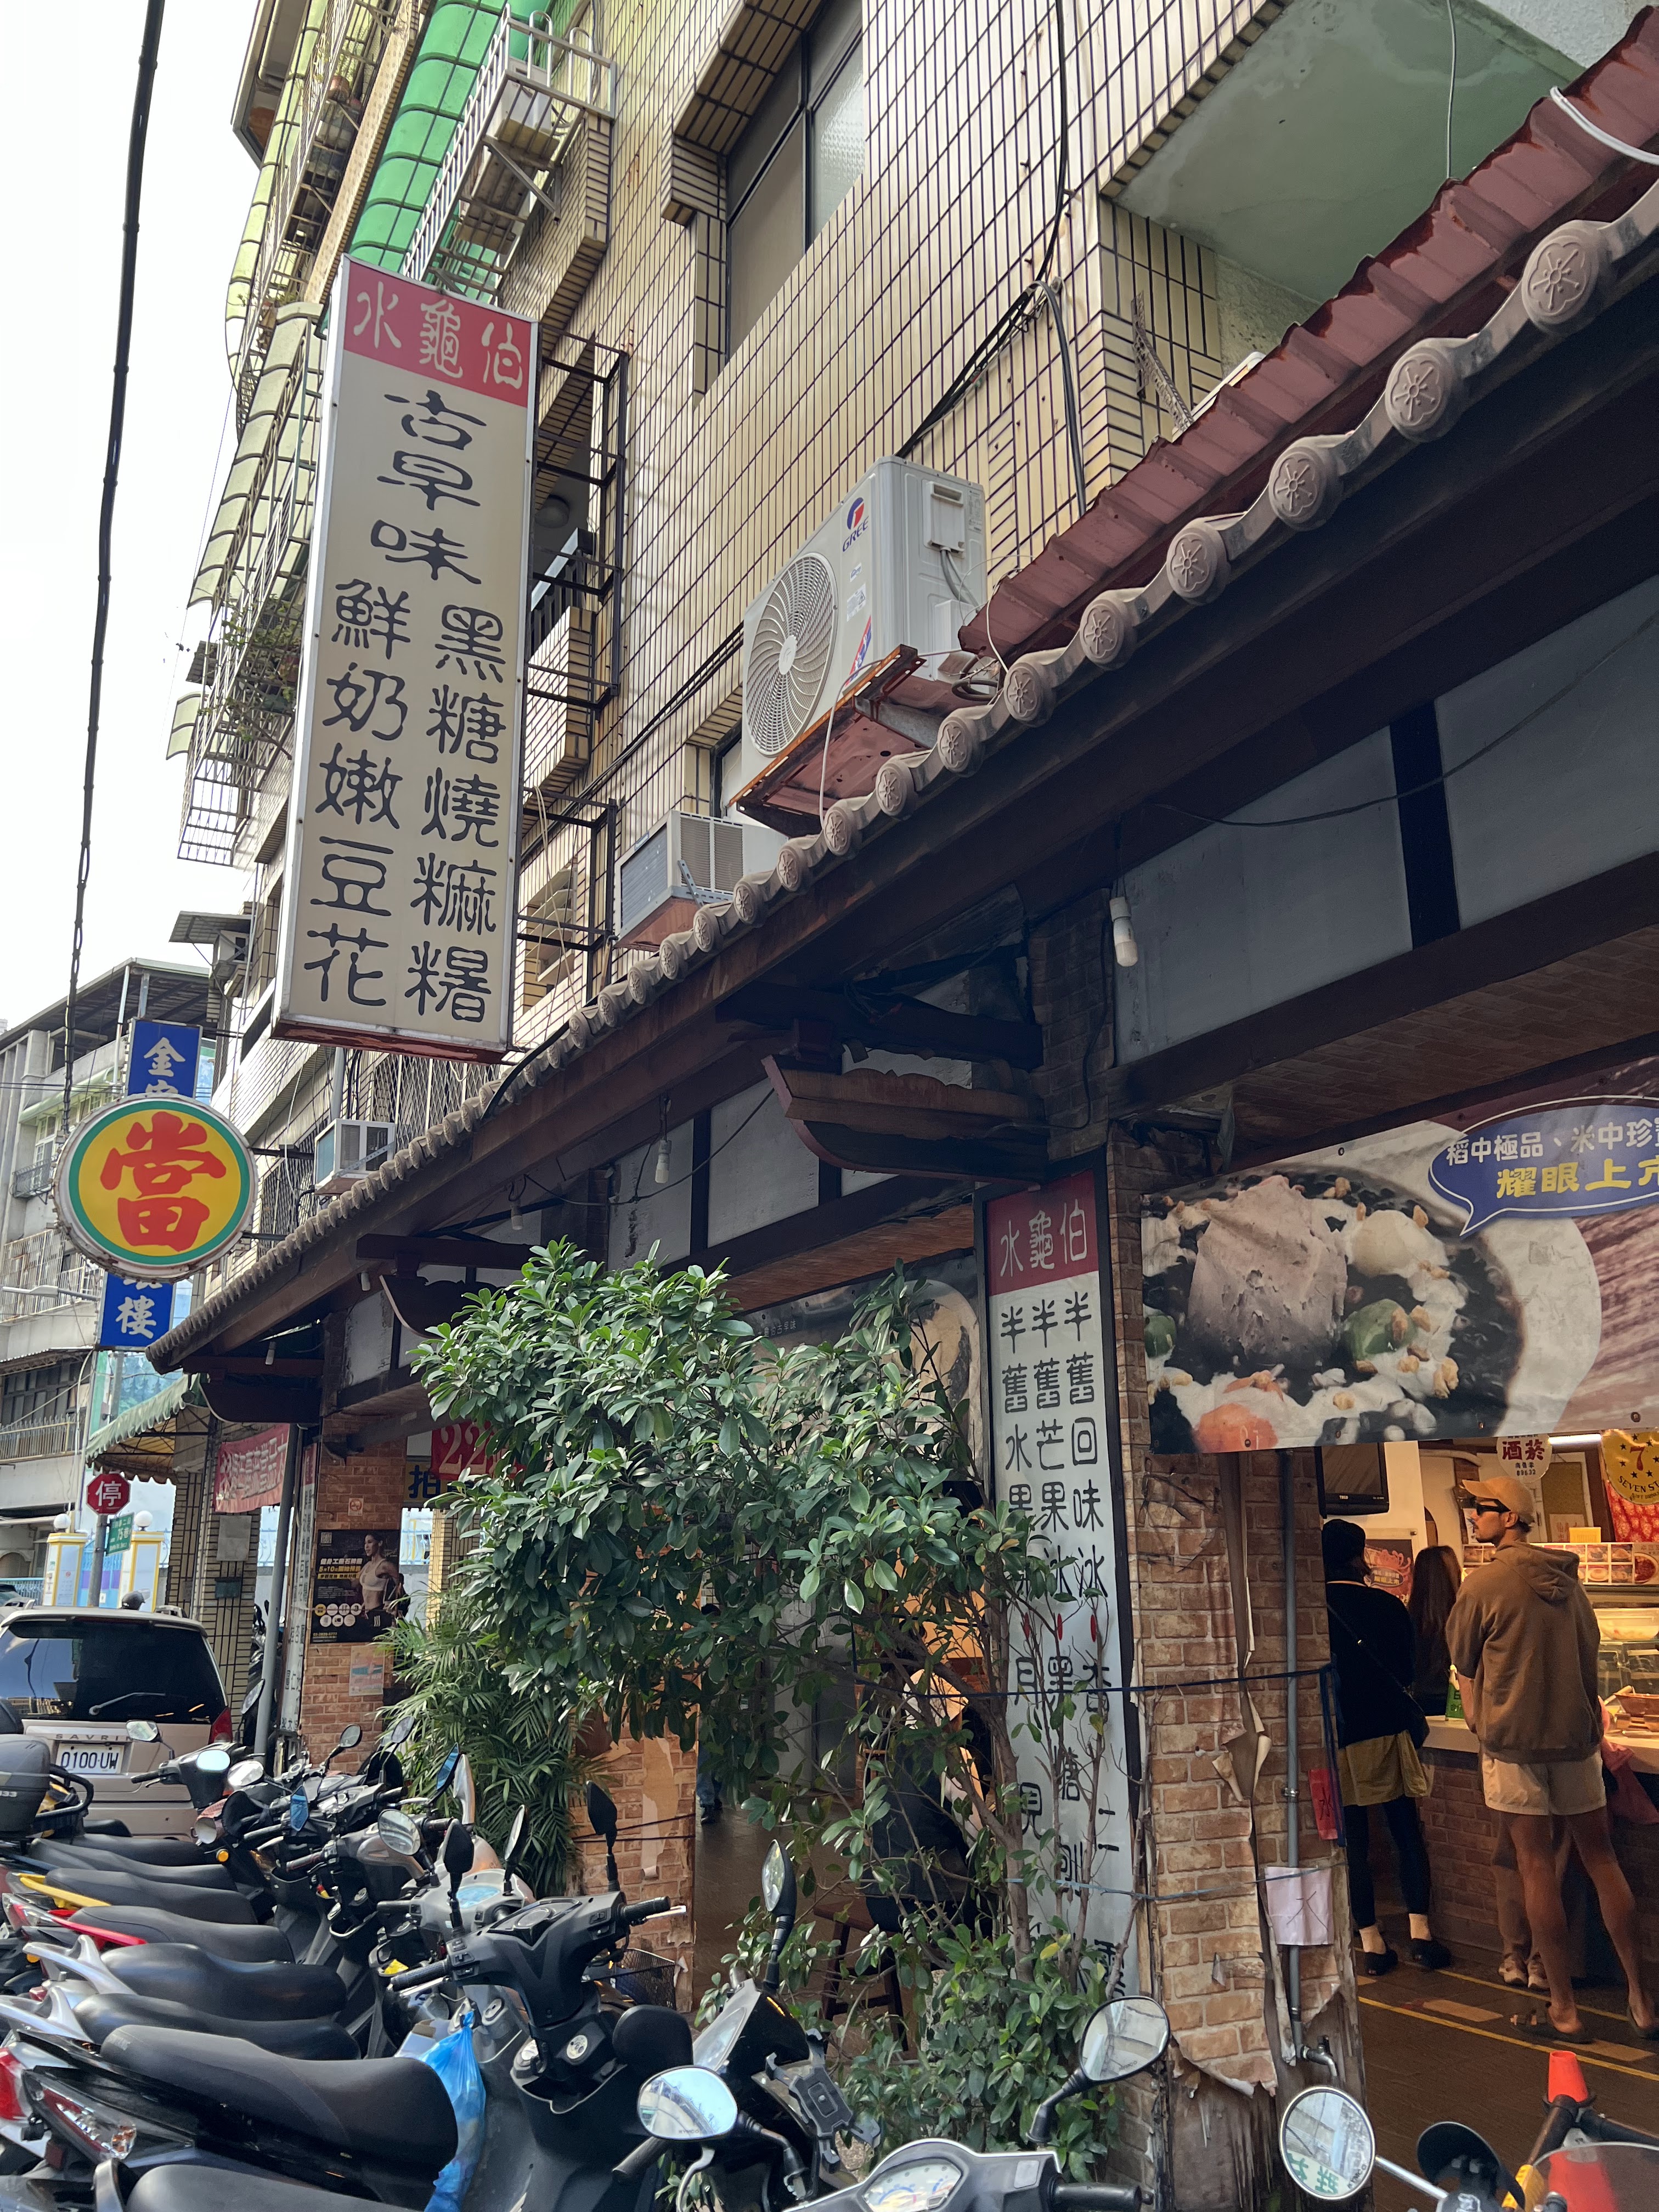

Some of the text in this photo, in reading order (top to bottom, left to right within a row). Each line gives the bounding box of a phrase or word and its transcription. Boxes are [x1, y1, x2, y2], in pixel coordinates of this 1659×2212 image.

[370, 389, 487, 585] 古早味
[843, 516, 870, 553] GREE
[304, 578, 411, 1007] 鮮奶嫩豆花
[100, 1111, 227, 1252] 當
[1000, 1198, 1088, 1278] 水龜伯
[1630, 1446, 1645, 1471] 7
[95, 1481, 122, 1507] 停
[1618, 1475, 1646, 1493] SEVEN
[56, 1734, 134, 1742] SAVRIN
